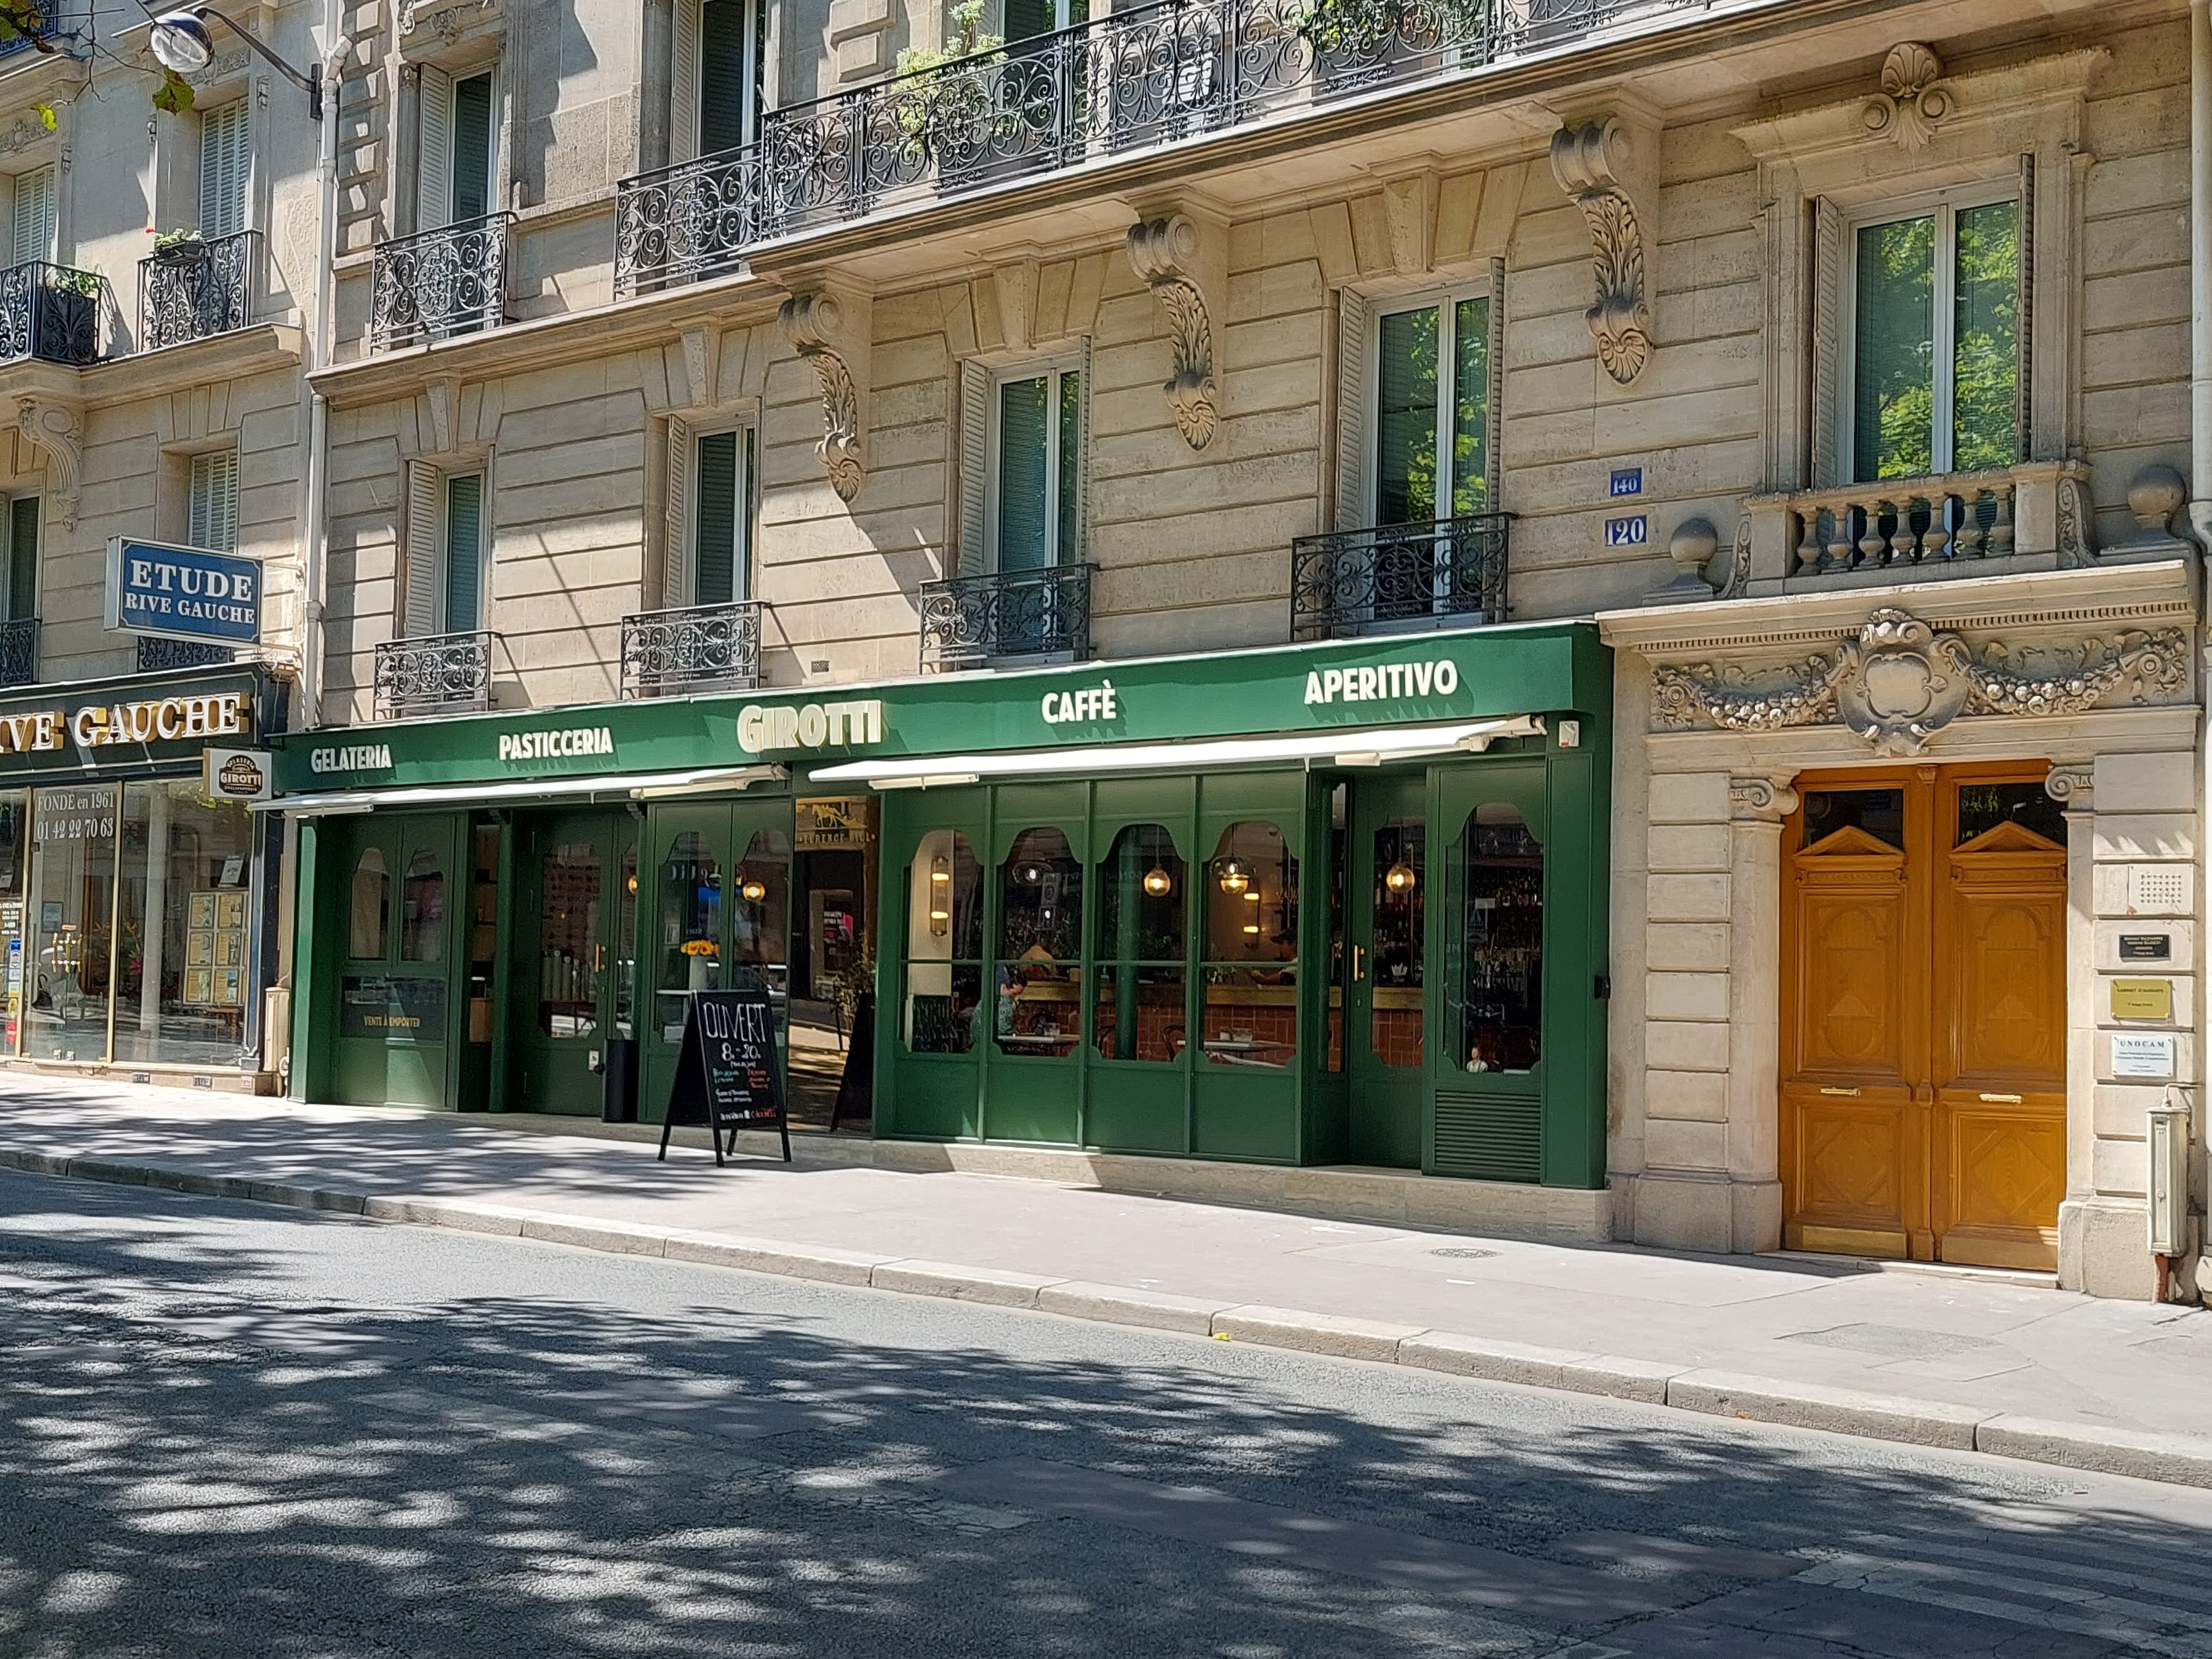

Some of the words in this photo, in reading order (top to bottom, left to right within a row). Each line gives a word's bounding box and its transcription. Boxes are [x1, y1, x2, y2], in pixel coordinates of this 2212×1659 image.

[1613, 478, 1637, 494] 140
[1607, 518, 1644, 545] 120
[130, 559, 252, 602] ETUDE
[125, 593, 171, 613] RIVE
[178, 599, 254, 624] GAUCHE
[1305, 660, 1458, 704] APERITIVO
[1042, 679, 1117, 724] CAFFÈ
[74, 693, 250, 747] GAUCHE
[737, 700, 881, 753] GIROTTI
[311, 744, 392, 773] GELATERIA
[499, 727, 614, 761] PASTICCERIA
[220, 772, 261, 787] GIROTTI
[77, 797, 88, 809] en
[91, 792, 114, 809] 1961
[37, 821, 49, 840] 01
[53, 819, 66, 839] 42
[68, 818, 82, 839] 22
[85, 818, 98, 839] 70
[364, 1014, 382, 1026] VENTE
[703, 1002, 766, 1043] OUVERT
